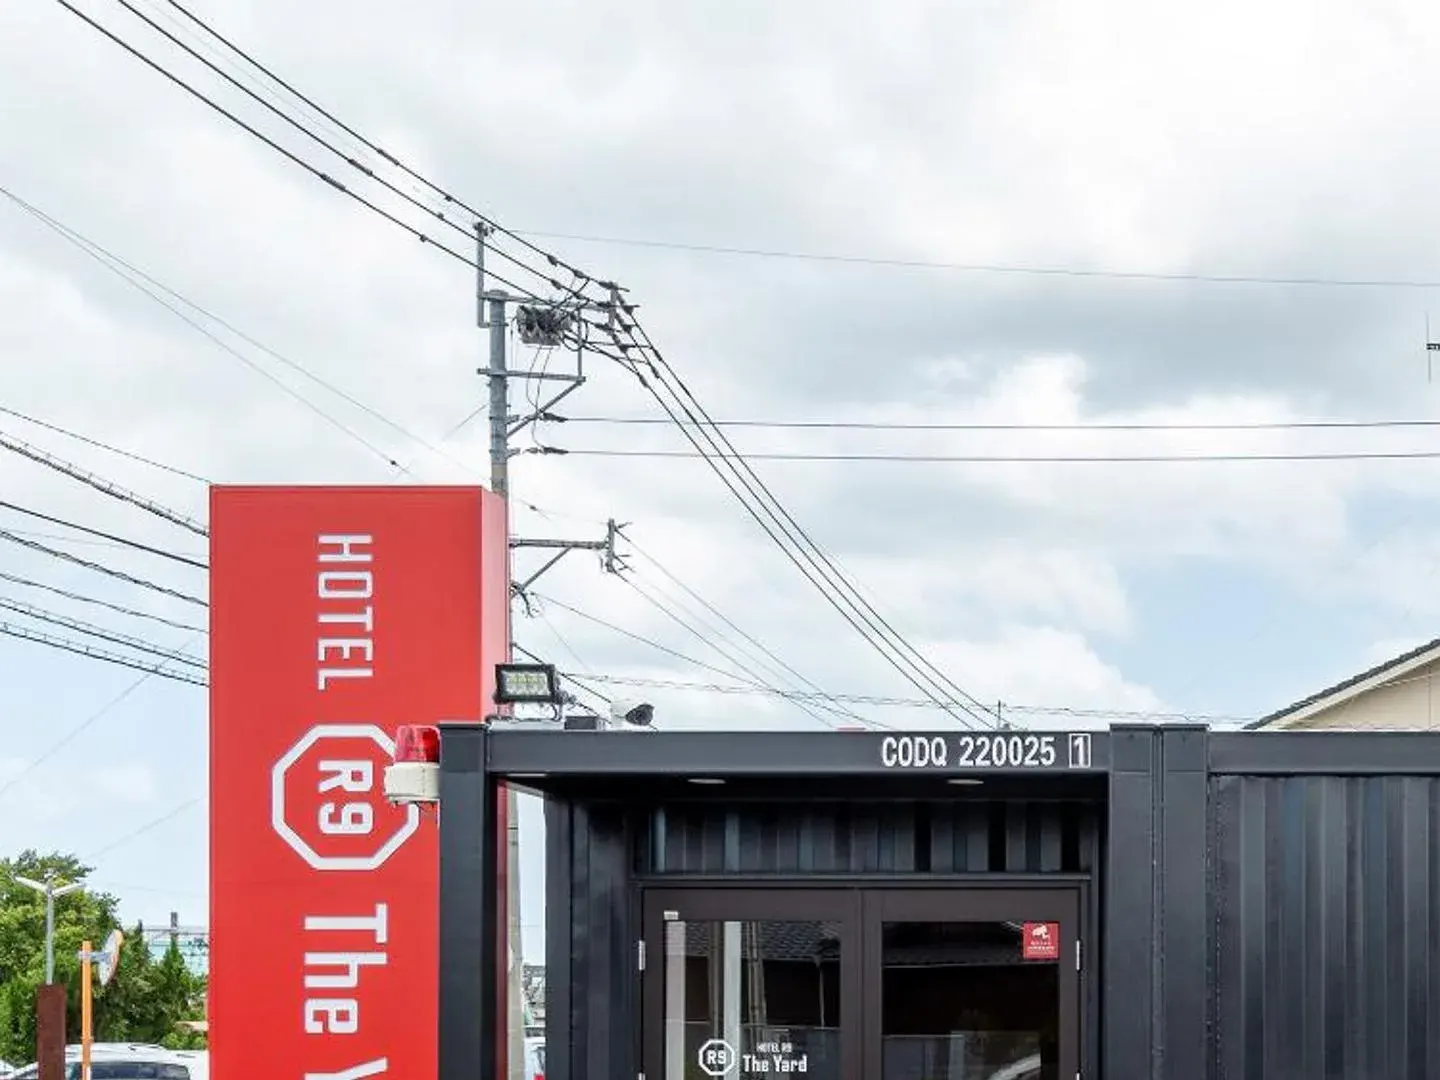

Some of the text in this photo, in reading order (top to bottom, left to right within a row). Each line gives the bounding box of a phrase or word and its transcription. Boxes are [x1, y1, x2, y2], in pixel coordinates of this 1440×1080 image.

[317, 534, 373, 690] HOTEL
[881, 736, 947, 767] CODQ
[959, 736, 1056, 766] 220025
[317, 759, 373, 835] R9
[303, 903, 388, 1035] The
[706, 1049, 727, 1065] R9
[742, 1053, 808, 1072] The Yard
